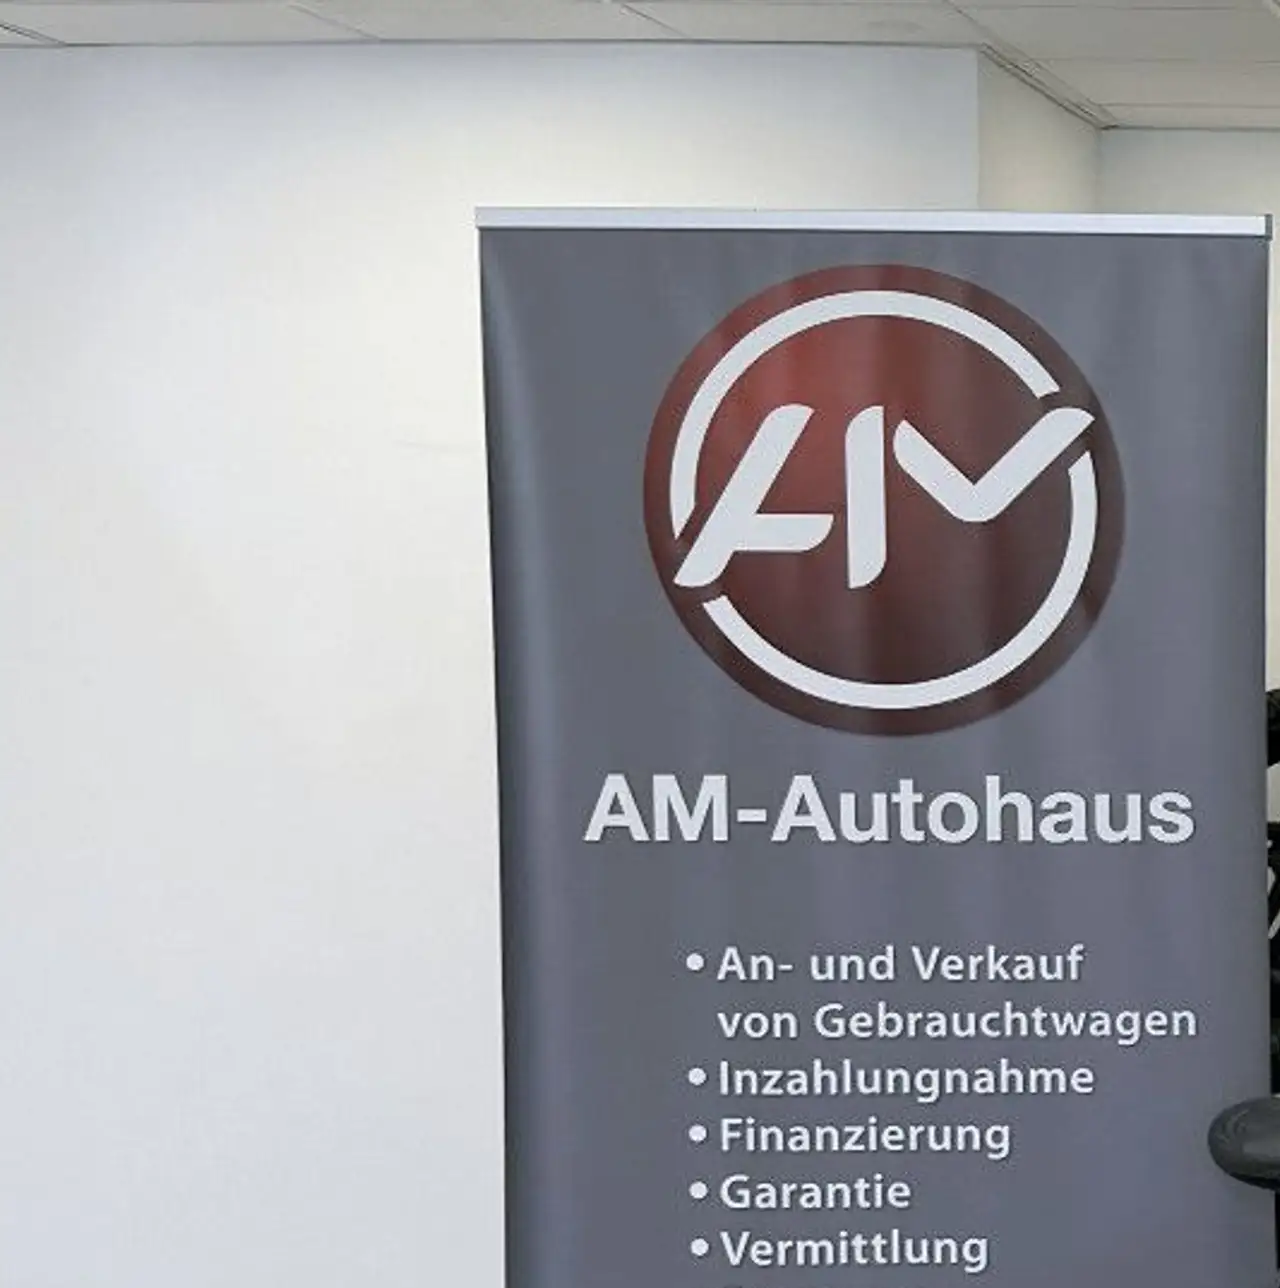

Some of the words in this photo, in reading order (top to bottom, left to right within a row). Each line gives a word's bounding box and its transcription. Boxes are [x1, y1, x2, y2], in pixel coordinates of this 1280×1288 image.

[583, 772, 1195, 844] AM-Autohaus
[716, 946, 793, 981] An-
[809, 944, 895, 981] und
[910, 943, 1085, 982] Verkauf
[717, 1011, 798, 1040] von
[813, 1001, 1198, 1046] Gebrauchtwagen
[719, 1058, 1095, 1103] Inzahlungnahme
[720, 1116, 1011, 1160] Finanzierung
[720, 1173, 912, 1210] Garantie
[719, 1228, 989, 1273] Vermittlung
